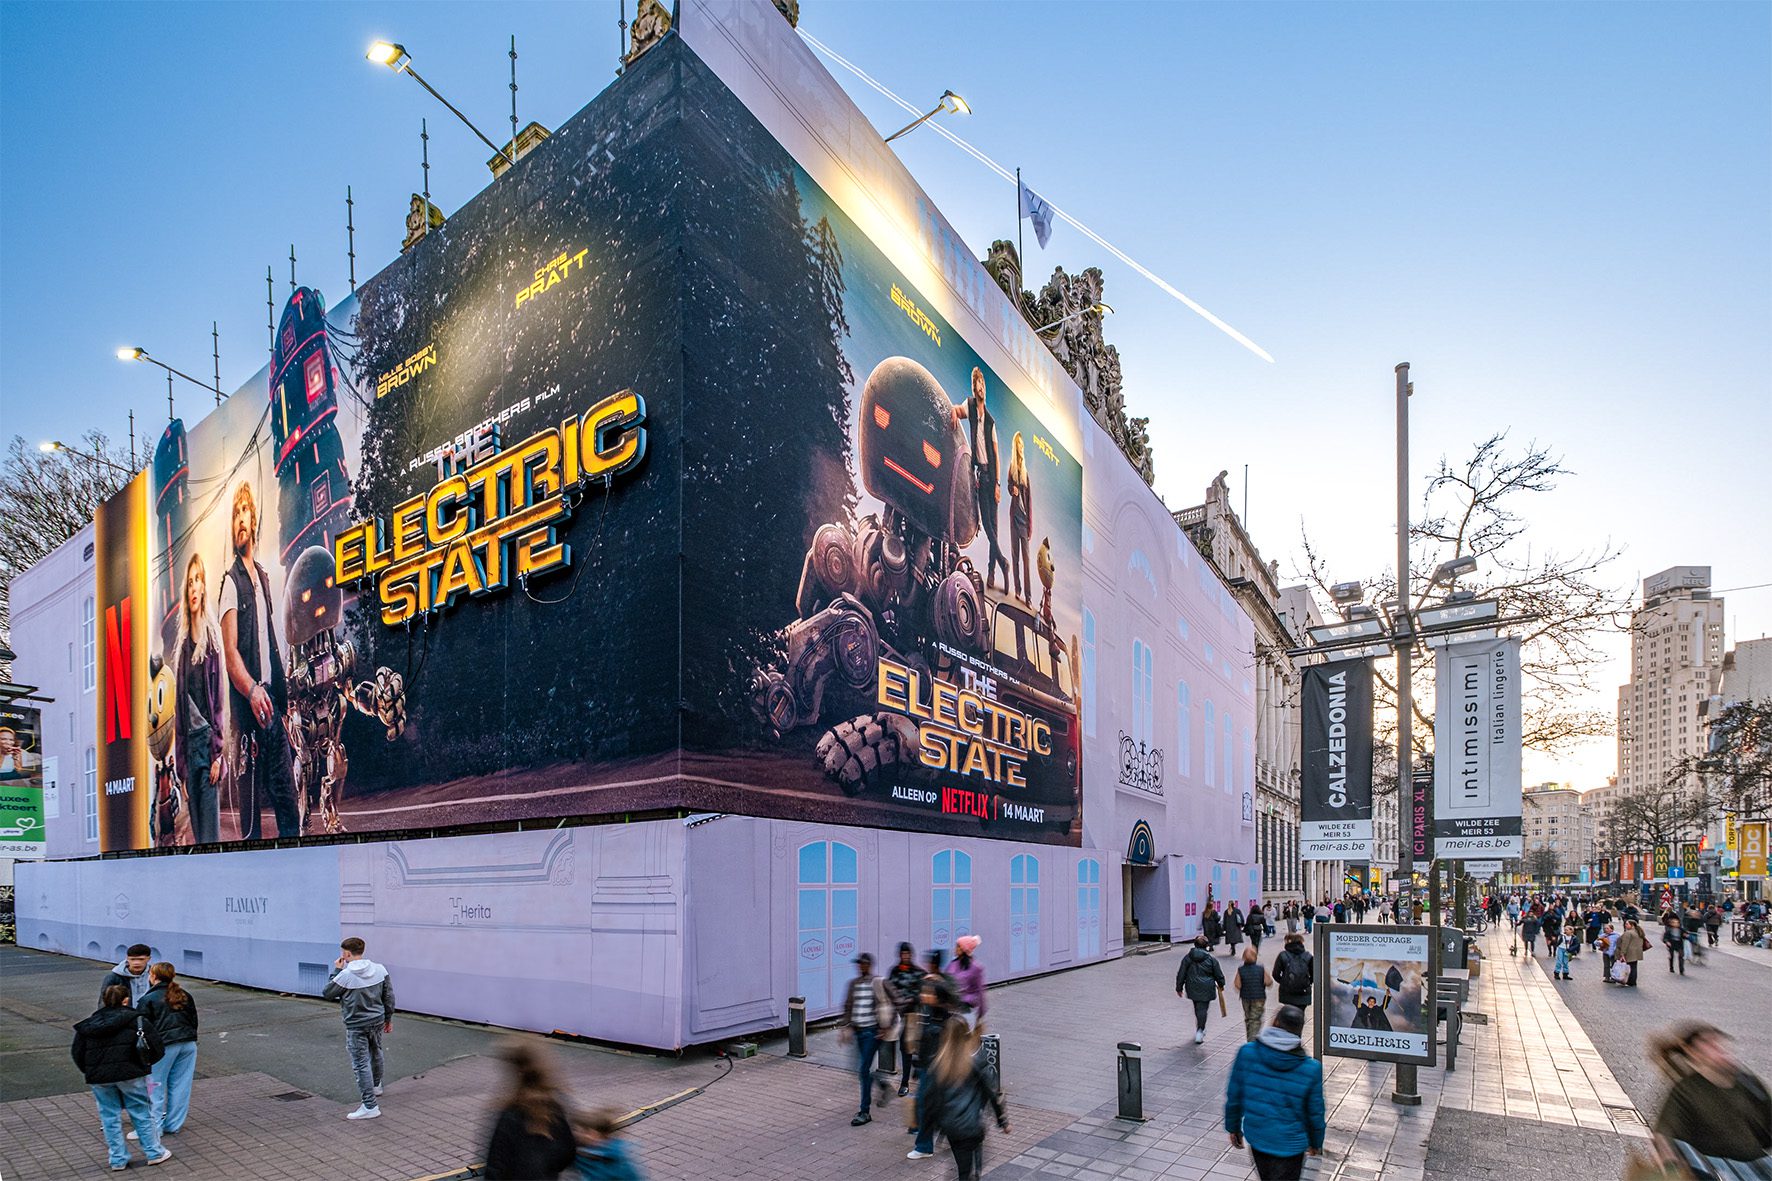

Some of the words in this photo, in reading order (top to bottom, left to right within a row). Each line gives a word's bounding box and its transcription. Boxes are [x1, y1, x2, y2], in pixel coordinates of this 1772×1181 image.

[516, 248, 588, 309] PRATT
[534, 251, 567, 280] CHRIS
[891, 287, 941, 347] BROWN
[376, 350, 437, 399] BROWN
[379, 362, 404, 384] MILLIE
[405, 343, 434, 367] BOBBY
[400, 468, 407, 476] A
[455, 397, 530, 444] BROTHERS
[535, 384, 561, 404] FILM
[432, 425, 499, 483] THE
[335, 389, 646, 587] ELECTRIC
[380, 494, 571, 627] STATE
[105, 596, 133, 744] N
[939, 642, 968, 661] RUSSO
[969, 656, 1008, 681] BROTHERS
[1009, 677, 1020, 685] FILM
[961, 666, 998, 701] THE
[1493, 651, 1507, 700] lingerie
[878, 656, 1052, 756] ELECTRIC
[1493, 704, 1504, 745] Italian
[1328, 671, 1347, 808] CALZEDONIA
[1462, 664, 1478, 798] intimissimi
[919, 720, 1028, 788] STATE
[105, 781, 113, 796] 14
[112, 776, 135, 795] MAART
[892, 785, 925, 803] ALLEEN
[925, 791, 938, 804] OP
[941, 786, 989, 820] NETFLIX
[1003, 802, 1013, 819] 14
[1014, 803, 1044, 823] MAART
[1414, 788, 1425, 802] XL
[1414, 806, 1425, 838] PARIS
[1461, 828, 1482, 836] MEIR
[1483, 819, 1500, 827] ZEE
[1310, 841, 1366, 852] meir-as.be
[1414, 842, 1425, 856] ICI
[1445, 838, 1511, 849] meir-as.be
[461, 904, 491, 919] Herita
[1336, 935, 1370, 943] MOEDER
[1371, 936, 1412, 944] COURAGE
